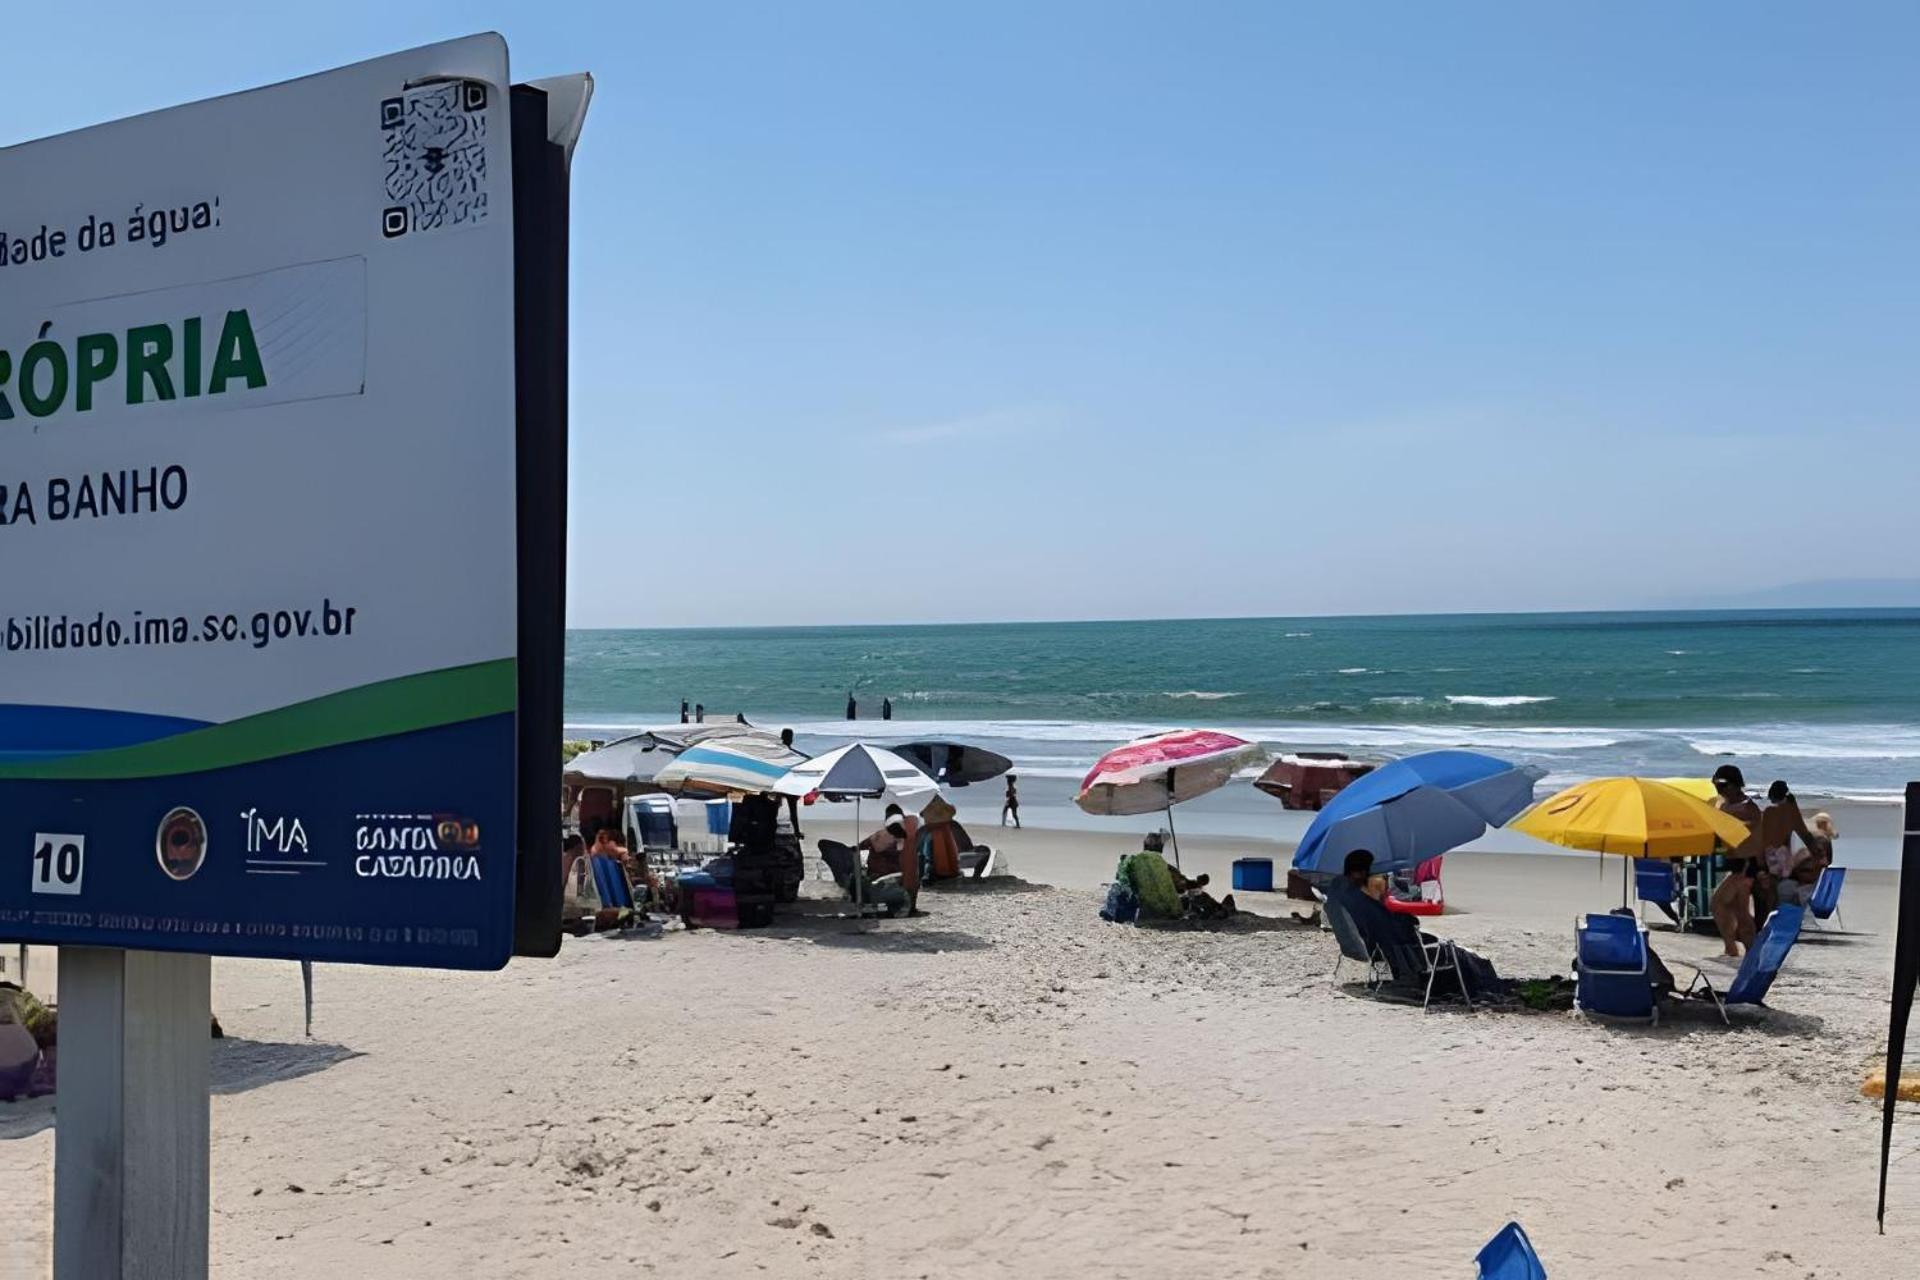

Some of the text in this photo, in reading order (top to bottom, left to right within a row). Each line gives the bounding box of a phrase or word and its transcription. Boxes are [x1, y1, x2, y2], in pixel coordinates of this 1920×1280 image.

[78, 215, 116, 252] da
[128, 195, 220, 248] água:
[48, 464, 188, 521] BANHO
[0, 598, 356, 651] bilidad.ima.sc.gov.br
[241, 808, 308, 853] IMA
[35, 842, 80, 884] 10
